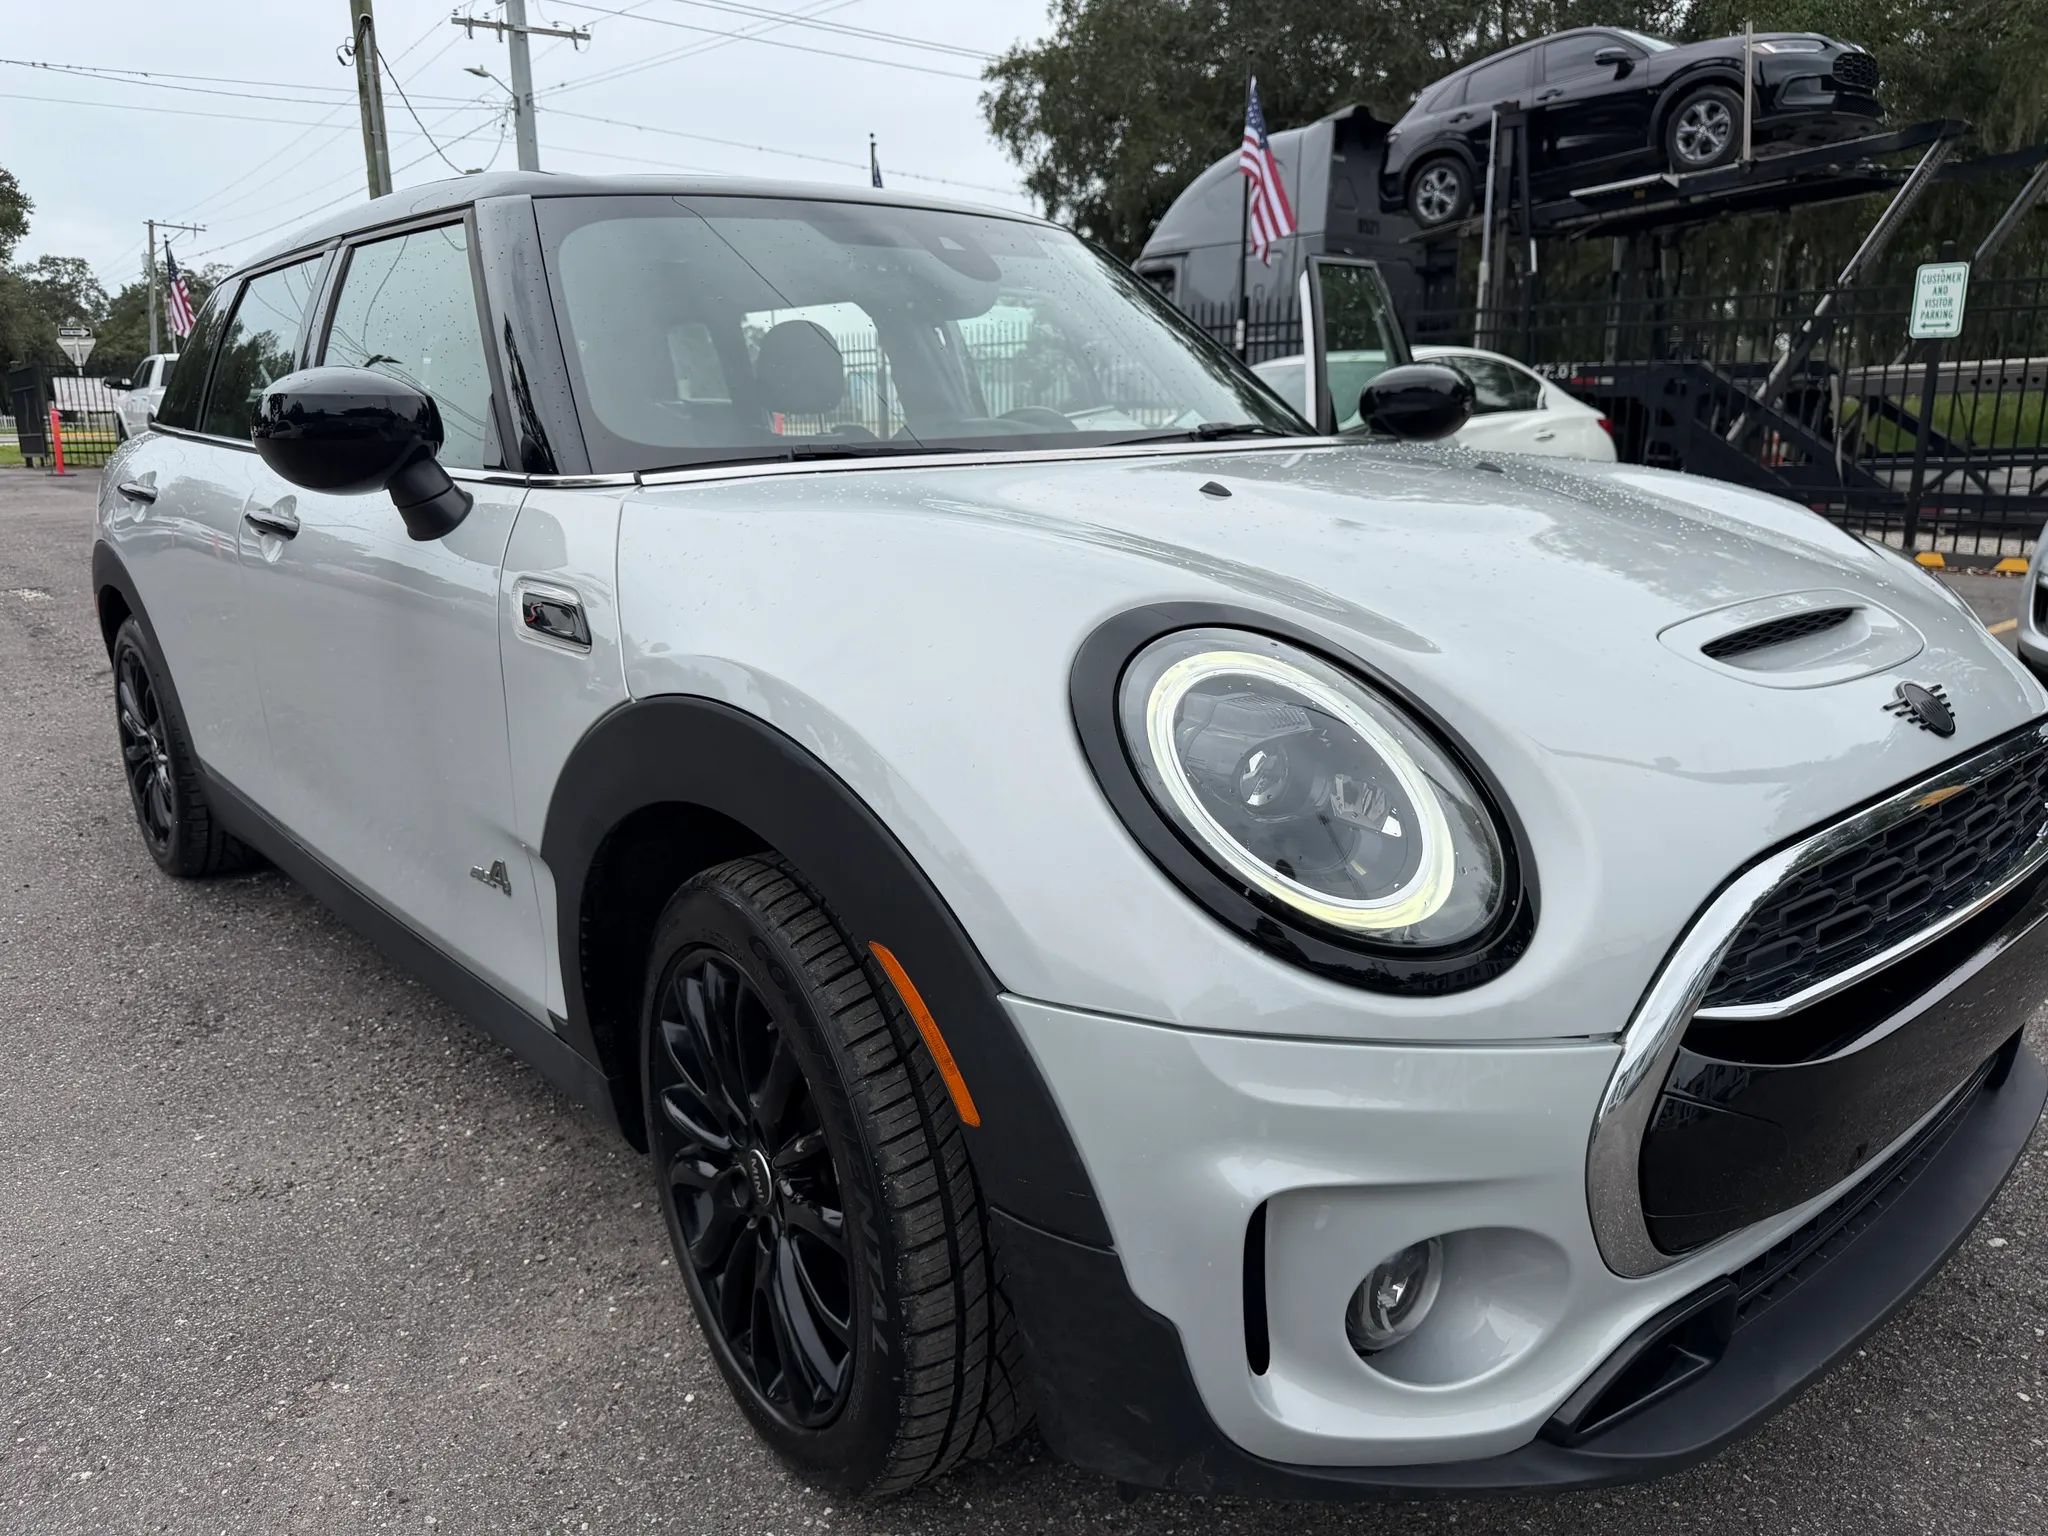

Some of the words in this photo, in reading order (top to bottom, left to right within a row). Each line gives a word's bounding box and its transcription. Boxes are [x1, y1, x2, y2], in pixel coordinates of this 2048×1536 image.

[1921, 271, 1962, 285] CUSTOMER
[1931, 285, 1949, 296] AND
[1924, 297, 1953, 309] VISITOR
[1920, 309, 1953, 320] PARKING
[751, 1158, 765, 1198] MINI
